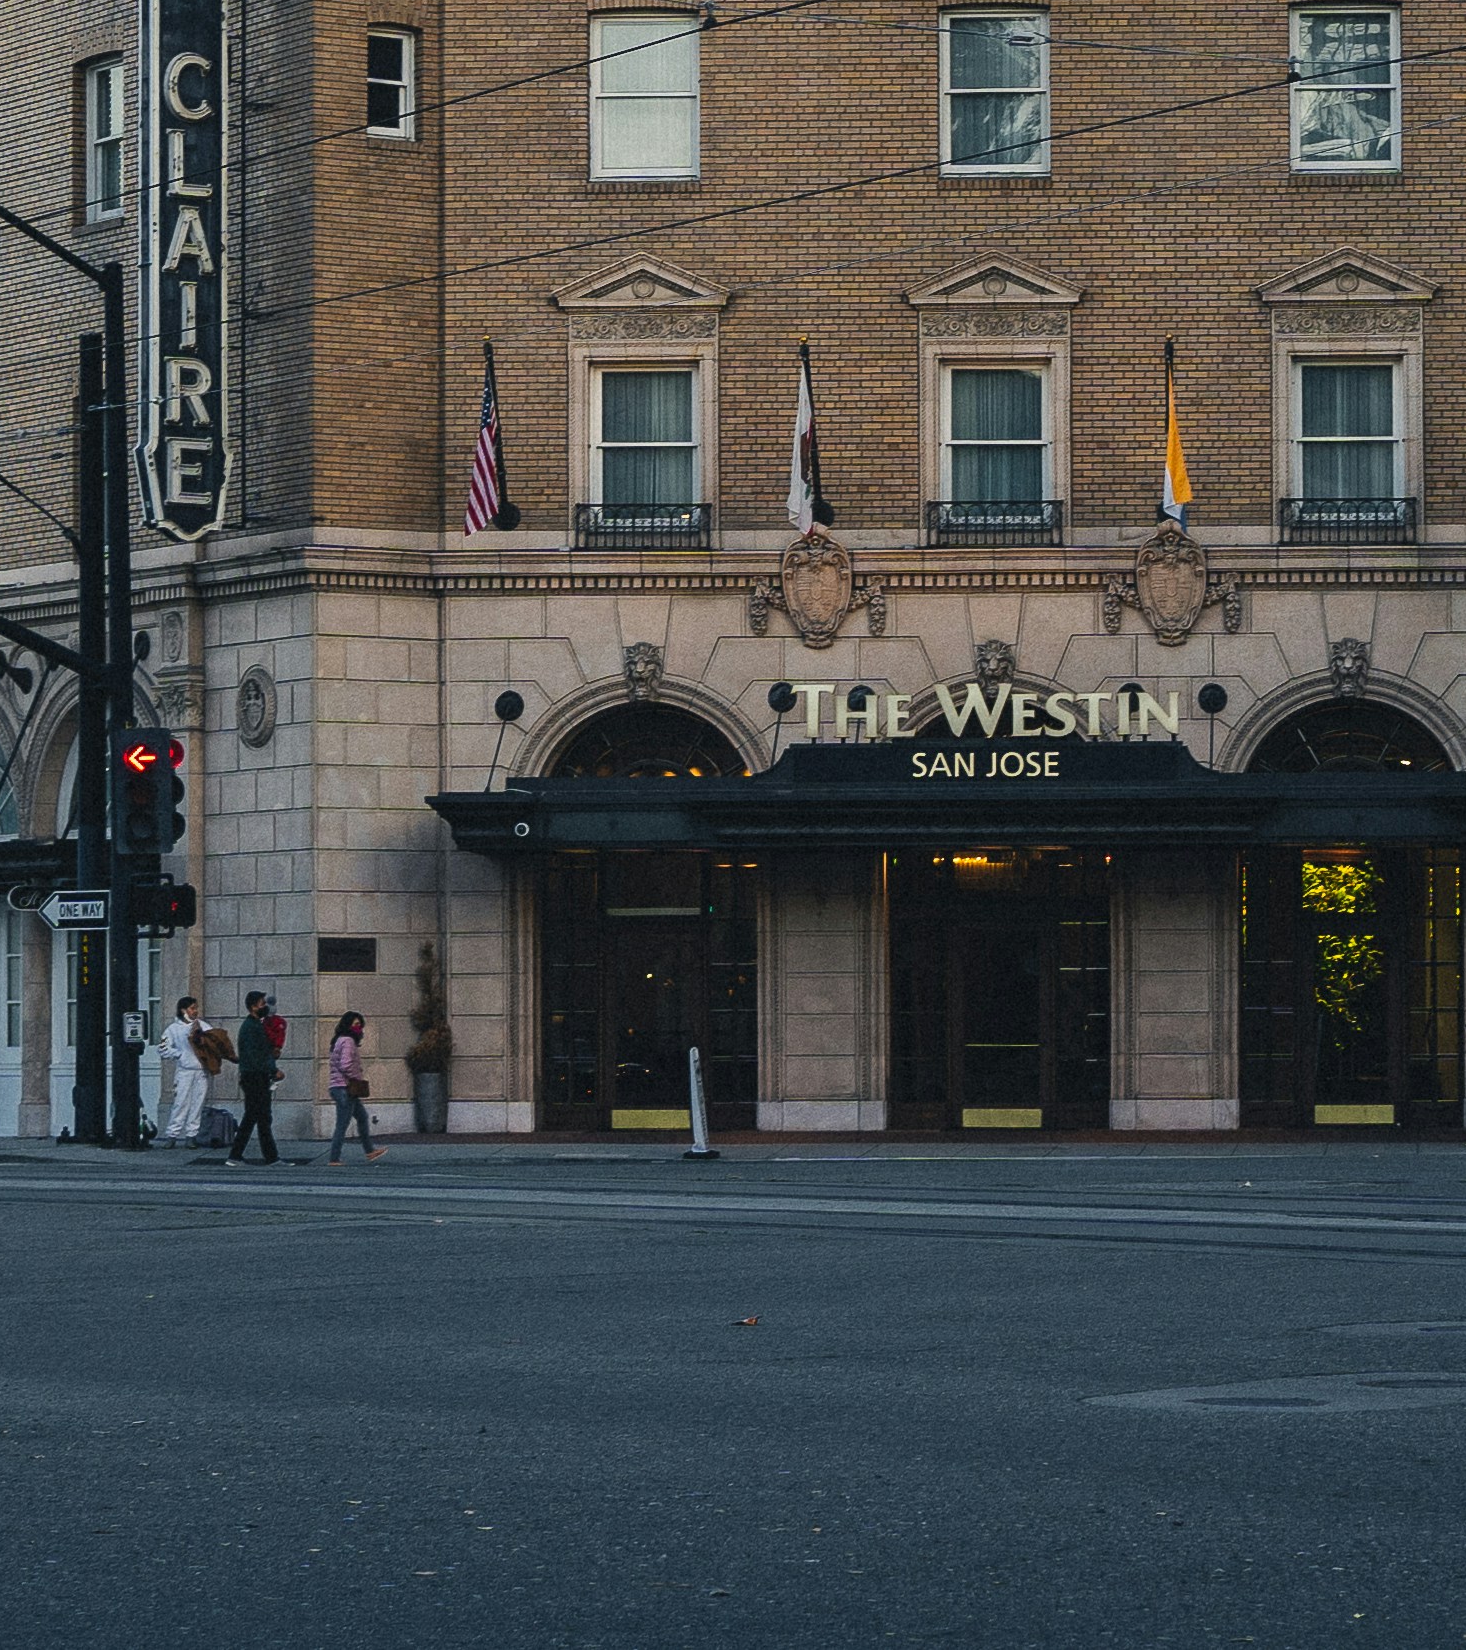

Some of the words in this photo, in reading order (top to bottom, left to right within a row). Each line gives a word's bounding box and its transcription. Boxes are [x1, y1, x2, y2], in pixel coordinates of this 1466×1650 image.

[162, 52, 215, 508] CLAIRE
[790, 684, 918, 739] THE
[935, 682, 1181, 739] WESTIN
[911, 752, 976, 778] SAN
[986, 751, 1060, 778] JOSE
[59, 903, 80, 917] ONE
[82, 903, 103, 917] WAY
